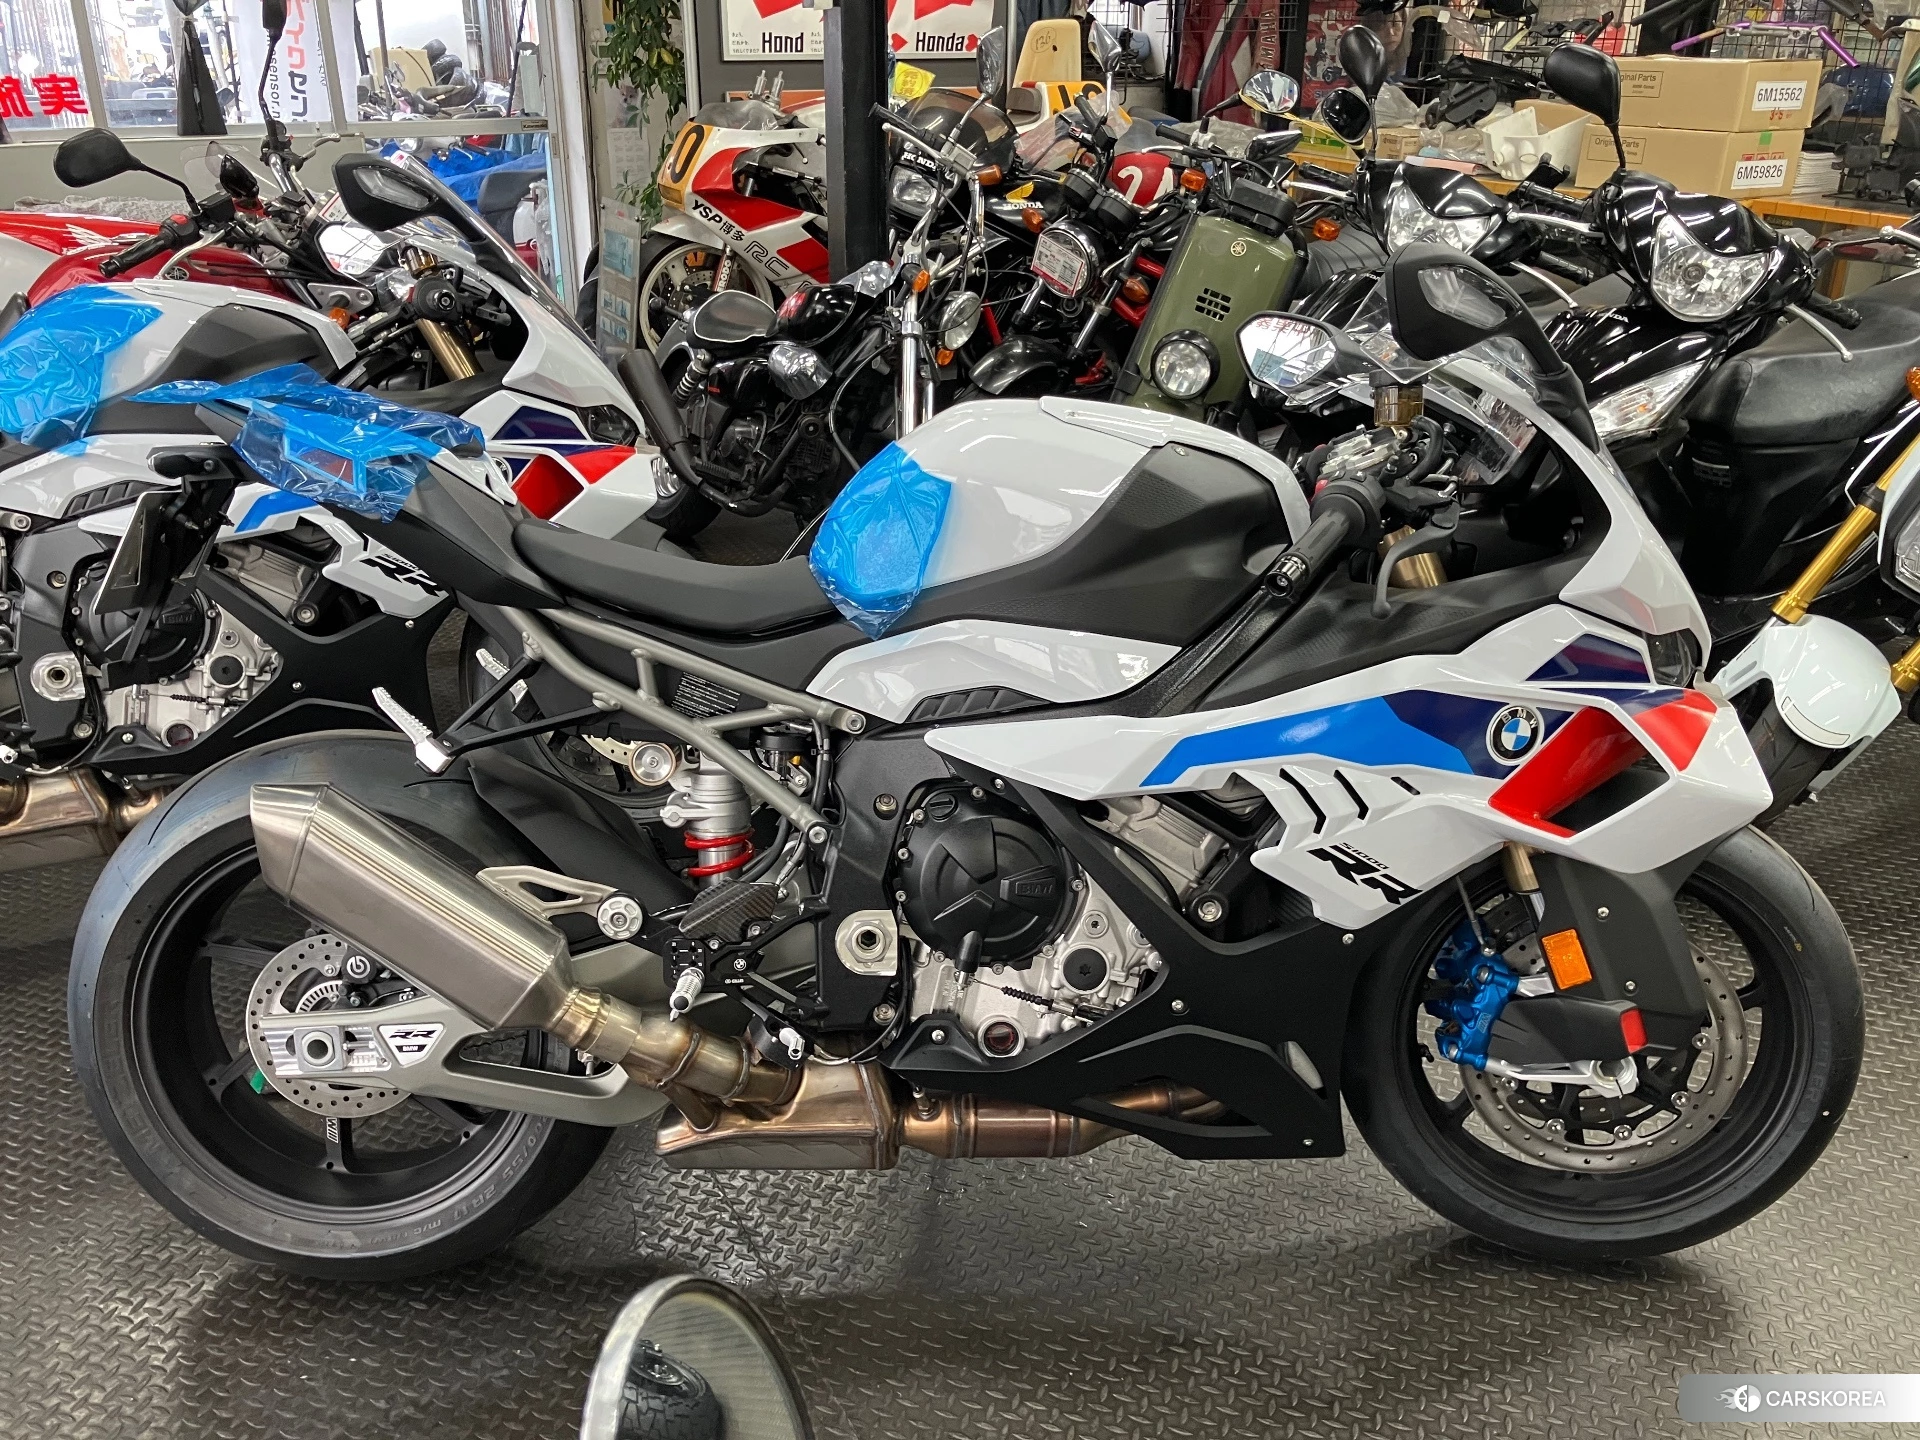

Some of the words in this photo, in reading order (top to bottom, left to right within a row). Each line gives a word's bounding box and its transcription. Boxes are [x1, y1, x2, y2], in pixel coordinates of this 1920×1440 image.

[915, 32, 965, 52] Honda
[1260, 8, 1277, 70] AMAHA
[1637, 74, 1657, 82] Parts
[1757, 88, 1803, 102] 6M15562
[1736, 165, 1784, 180] 6M59826
[1002, 201, 1044, 210] HONDA
[1501, 709, 1538, 729] BMW
[1339, 842, 1390, 870] S1000
[1306, 844, 1423, 906] RR
[389, 1029, 437, 1040] RR
